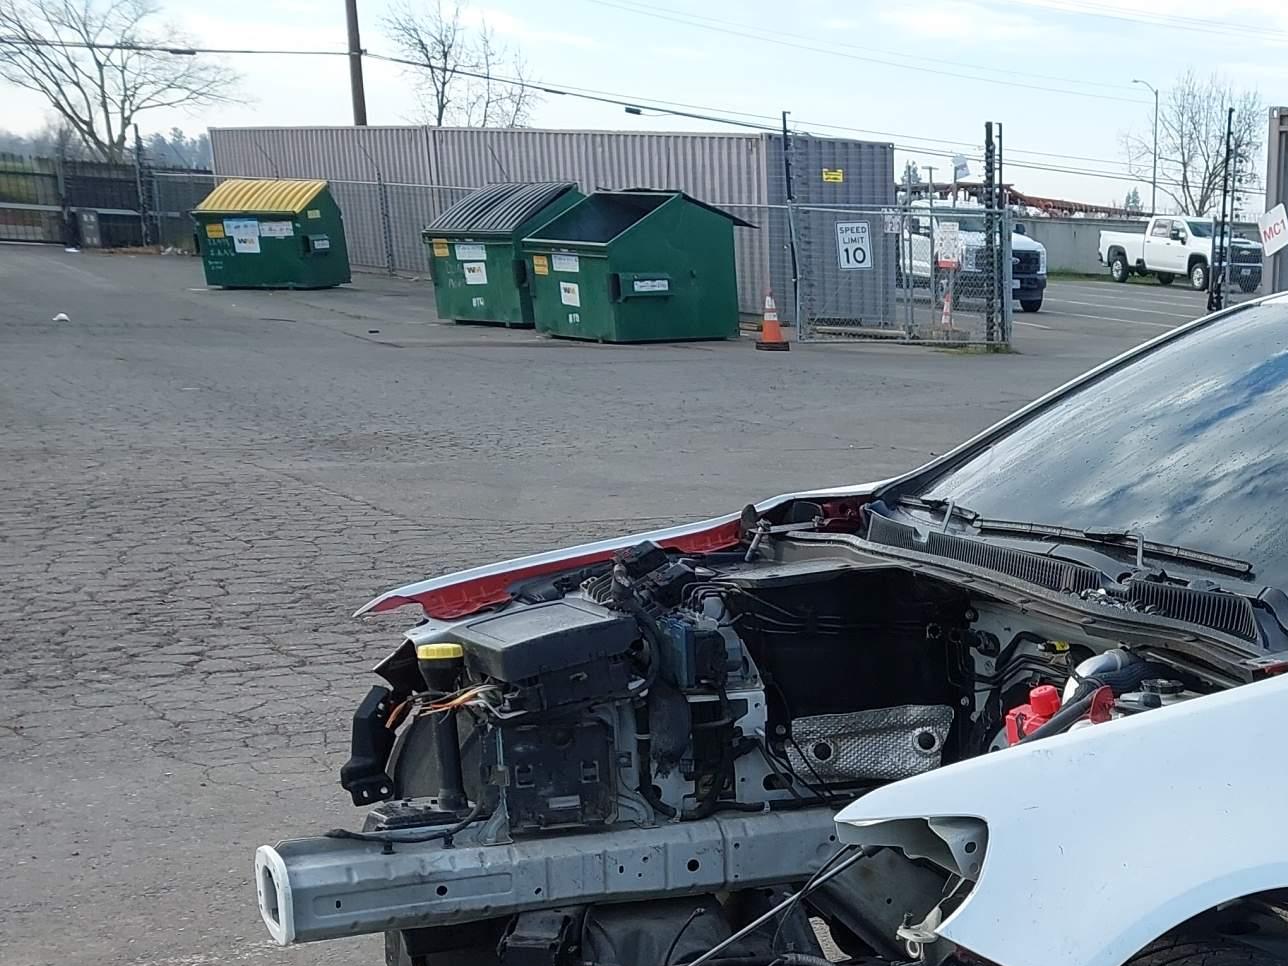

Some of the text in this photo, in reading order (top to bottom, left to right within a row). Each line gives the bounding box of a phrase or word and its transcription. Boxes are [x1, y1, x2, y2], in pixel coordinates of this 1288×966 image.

[839, 226, 867, 234] SPEED
[1263, 219, 1286, 243] MC1
[843, 236, 865, 244] LIMIT
[843, 247, 866, 264] 10
